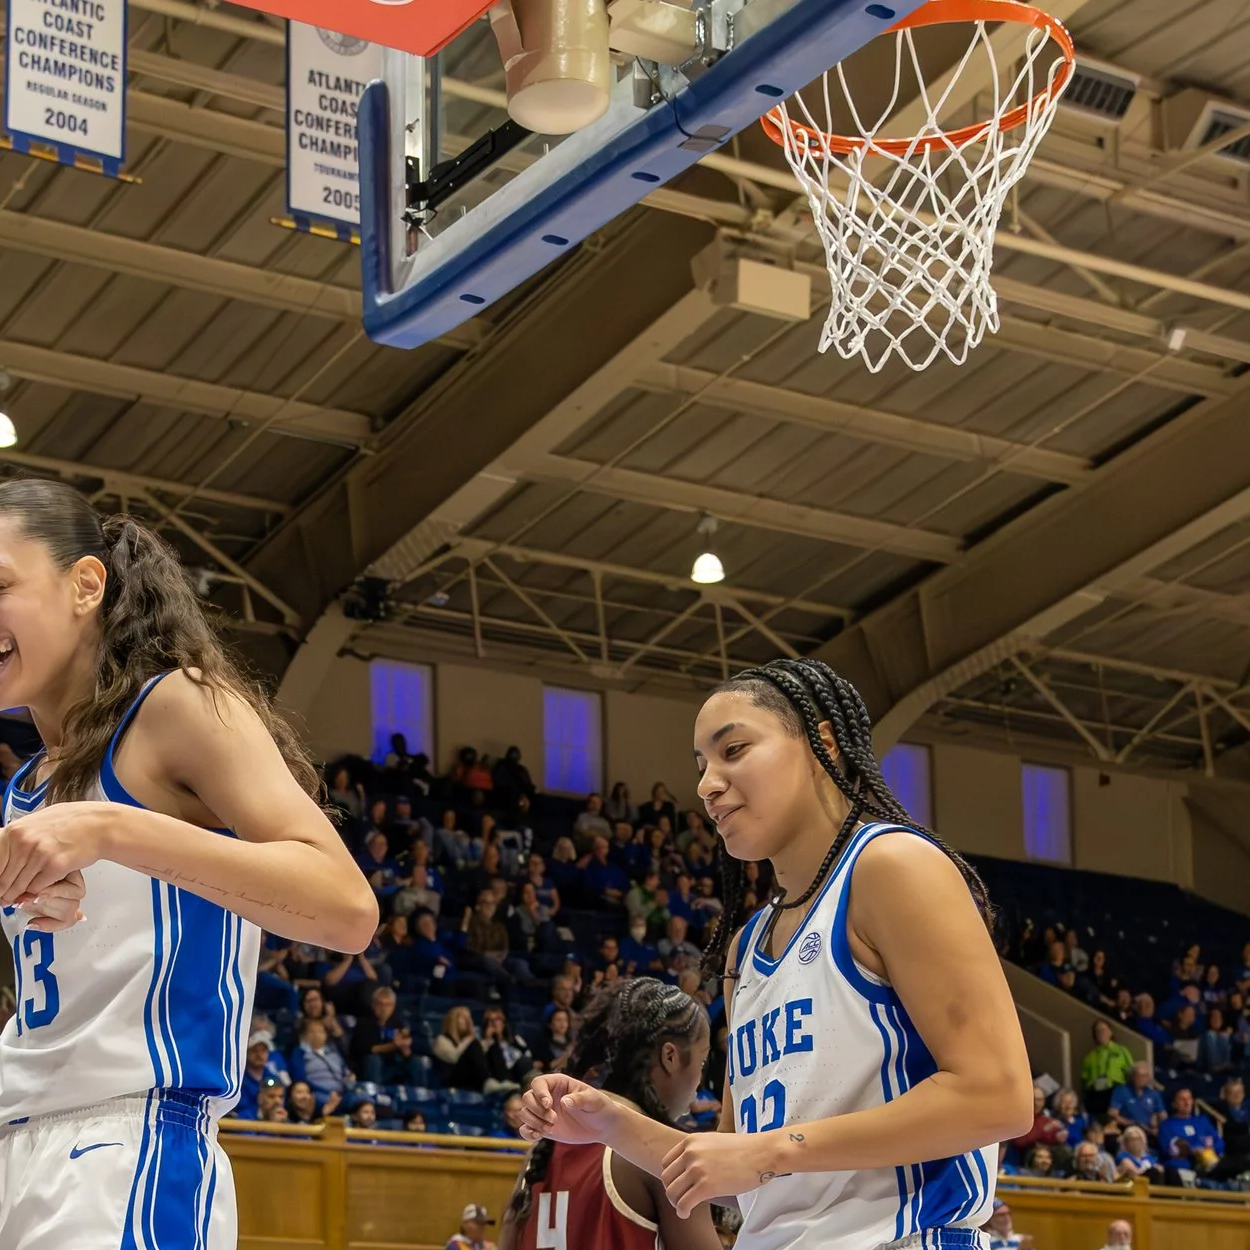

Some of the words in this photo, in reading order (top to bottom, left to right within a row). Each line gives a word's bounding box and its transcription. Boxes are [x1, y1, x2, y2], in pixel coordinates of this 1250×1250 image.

[43, 11, 94, 40] COAST
[14, 27, 119, 71] CONFERENCE
[19, 51, 115, 93] CHAMPIONS
[308, 69, 366, 97] ATLANT
[26, 81, 70, 101] REGULAR
[71, 93, 108, 113] SEASON
[319, 94, 358, 120] COAS
[45, 108, 88, 136] 2004
[294, 109, 358, 141] CONFER
[298, 132, 358, 163] CHAMPI
